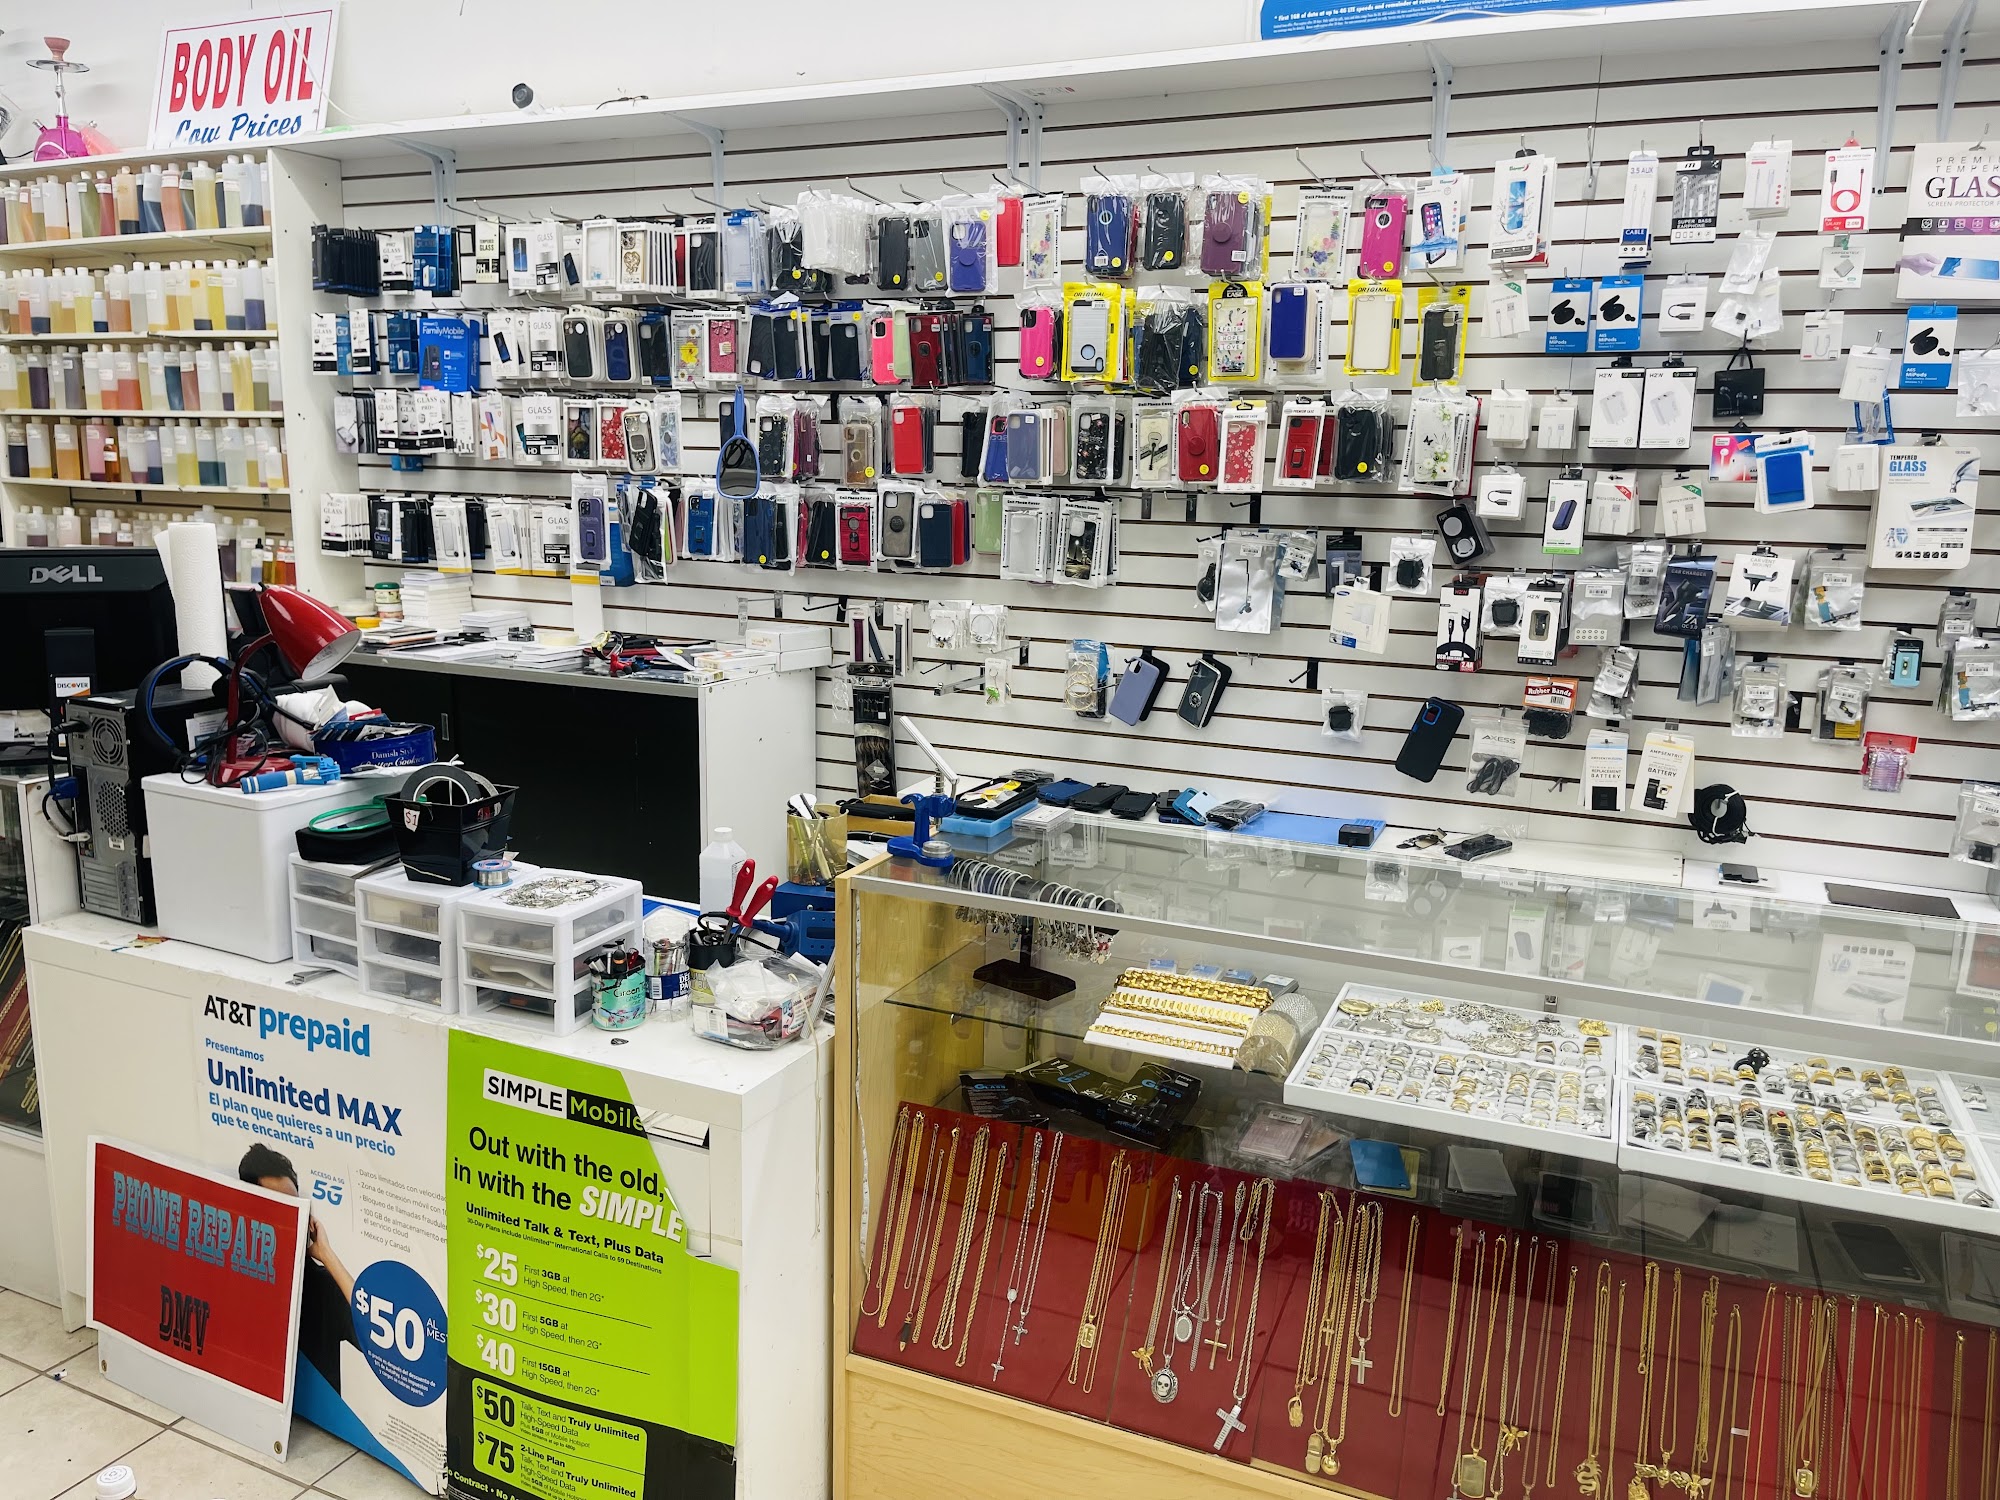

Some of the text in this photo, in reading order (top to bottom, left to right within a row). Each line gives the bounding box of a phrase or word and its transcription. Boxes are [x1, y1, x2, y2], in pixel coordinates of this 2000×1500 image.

[1326, 10, 1332, 18] up
[1356, 4, 1374, 14] speeds
[1374, 2, 1385, 10] and
[1385, 0, 1412, 9] remainder
[169, 27, 313, 113] BODY OIL
[228, 112, 302, 142] Prices
[1630, 166, 1654, 175] 3.5 AUX
[1677, 217, 1713, 226] SUPER BASS
[536, 233, 553, 242] GLASS
[479, 244, 495, 252] GLASS
[533, 321, 552, 330] GLASS
[416, 396, 438, 404] GLASS
[527, 406, 552, 415] GLASS
[1889, 460, 1927, 472] GLASS
[1618, 486, 1630, 496] 3FT
[1687, 485, 1699, 494] 3FT
[29, 565, 103, 584] DELL
[1684, 614, 1698, 625] 7A
[1527, 686, 1573, 697] Rubber Bands
[1481, 733, 1516, 745] AXESS
[371, 749, 399, 759] Danish
[1647, 767, 1677, 777] BATTERY
[405, 811, 418, 827] $1
[613, 986, 640, 998] Green
[204, 994, 371, 1058] AT&T prepaid
[205, 1037, 265, 1062] Presentamos
[1057, 1071, 1090, 1083] GLASS
[207, 1058, 403, 1137] Unlimited MAX
[1123, 1092, 1138, 1101] XS
[1141, 1078, 1182, 1098] GLASS
[487, 1076, 644, 1131] SIMPLE Mobile
[209, 1092, 396, 1157] El plan que quieres a un precio
[211, 1111, 315, 1150] que te encantará
[310, 1169, 332, 1180] ACCESO
[469, 1126, 665, 1203] Out with the old,
[311, 1179, 343, 1206] 5G
[454, 1157, 684, 1243] in with the SIMPLE
[112, 1171, 277, 1284] PHONE REPAIR
[370, 1220, 392, 1233] servicio
[392, 1227, 409, 1239] cloud
[466, 1201, 664, 1265] Unlimited Talk & Text, Plus Data
[364, 1230, 384, 1243] México
[389, 1239, 411, 1253] Canadá
[485, 1222, 501, 1233] Plans
[554, 1241, 593, 1257] International
[593, 1250, 609, 1260] Calls
[625, 1258, 662, 1275] Destinations
[476, 1243, 518, 1287] $25
[524, 1264, 570, 1283] First 3GB at
[523, 1277, 541, 1291] High
[542, 1281, 569, 1297] Speed,
[570, 1288, 588, 1300] then
[159, 1284, 210, 1355] DMV
[475, 1288, 517, 1332] $30
[355, 1287, 425, 1362] $50
[426, 1317, 439, 1331] AL
[522, 1311, 568, 1330] First 5GB at
[476, 1333, 516, 1377] $40
[522, 1356, 570, 1377] First 15GB at
[476, 1385, 515, 1428] $50
[520, 1400, 534, 1415] Talk,
[536, 1406, 551, 1419] Text
[552, 1412, 567, 1424] and
[568, 1416, 592, 1432] Truly
[594, 1423, 640, 1442] Unlimited
[520, 1410, 579, 1437] High-Speed Data
[477, 1431, 515, 1474] $75
[520, 1444, 566, 1468] 2-Line Plan
